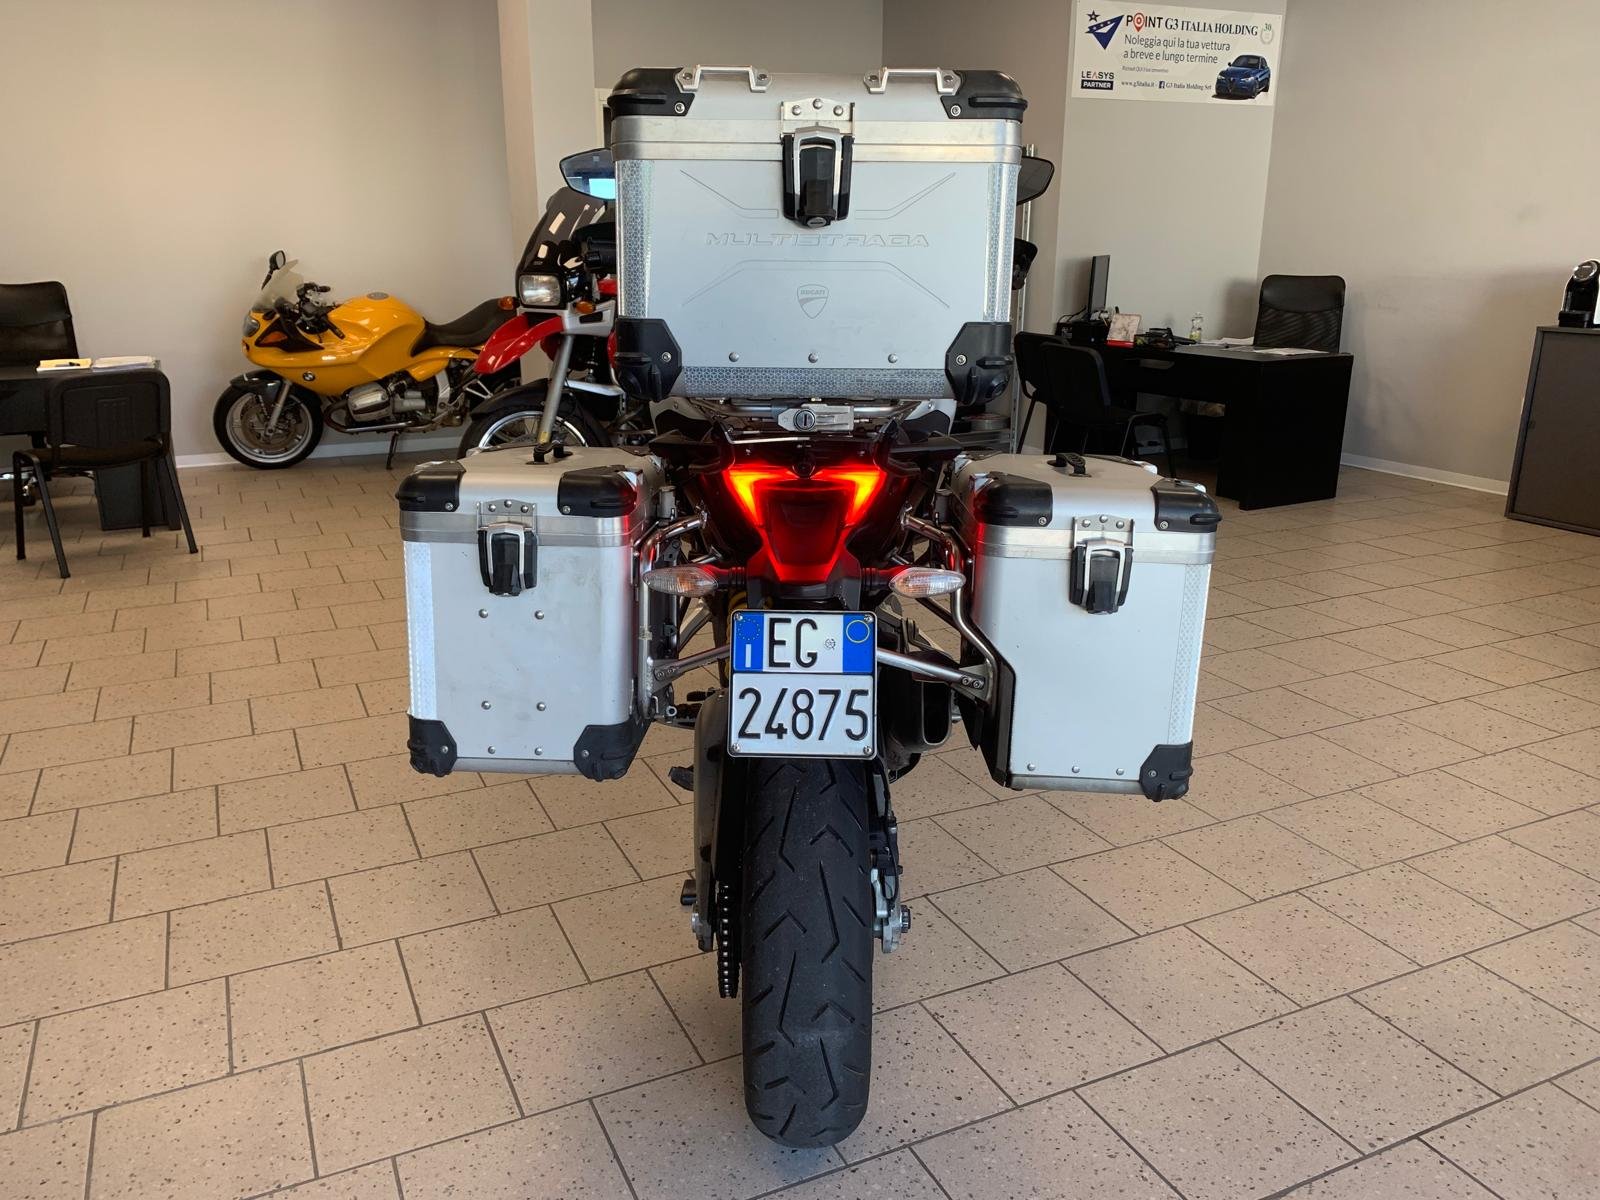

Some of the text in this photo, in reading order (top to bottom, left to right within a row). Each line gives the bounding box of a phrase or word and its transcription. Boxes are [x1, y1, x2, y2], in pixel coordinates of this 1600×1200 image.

[1126, 13, 1258, 36] POINT G3 ITALIA HOLDING
[1124, 34, 1231, 51] Noleggia qui la tua vettura
[1130, 48, 1154, 60] breve
[1161, 50, 1185, 64] lungo
[1186, 53, 1218, 64] termine
[1081, 71, 1115, 80] LEASYS
[1083, 81, 1112, 89] PARTNER
[705, 232, 930, 248] MULTISTRADA
[768, 617, 818, 668] EG
[738, 687, 869, 741] 24875
